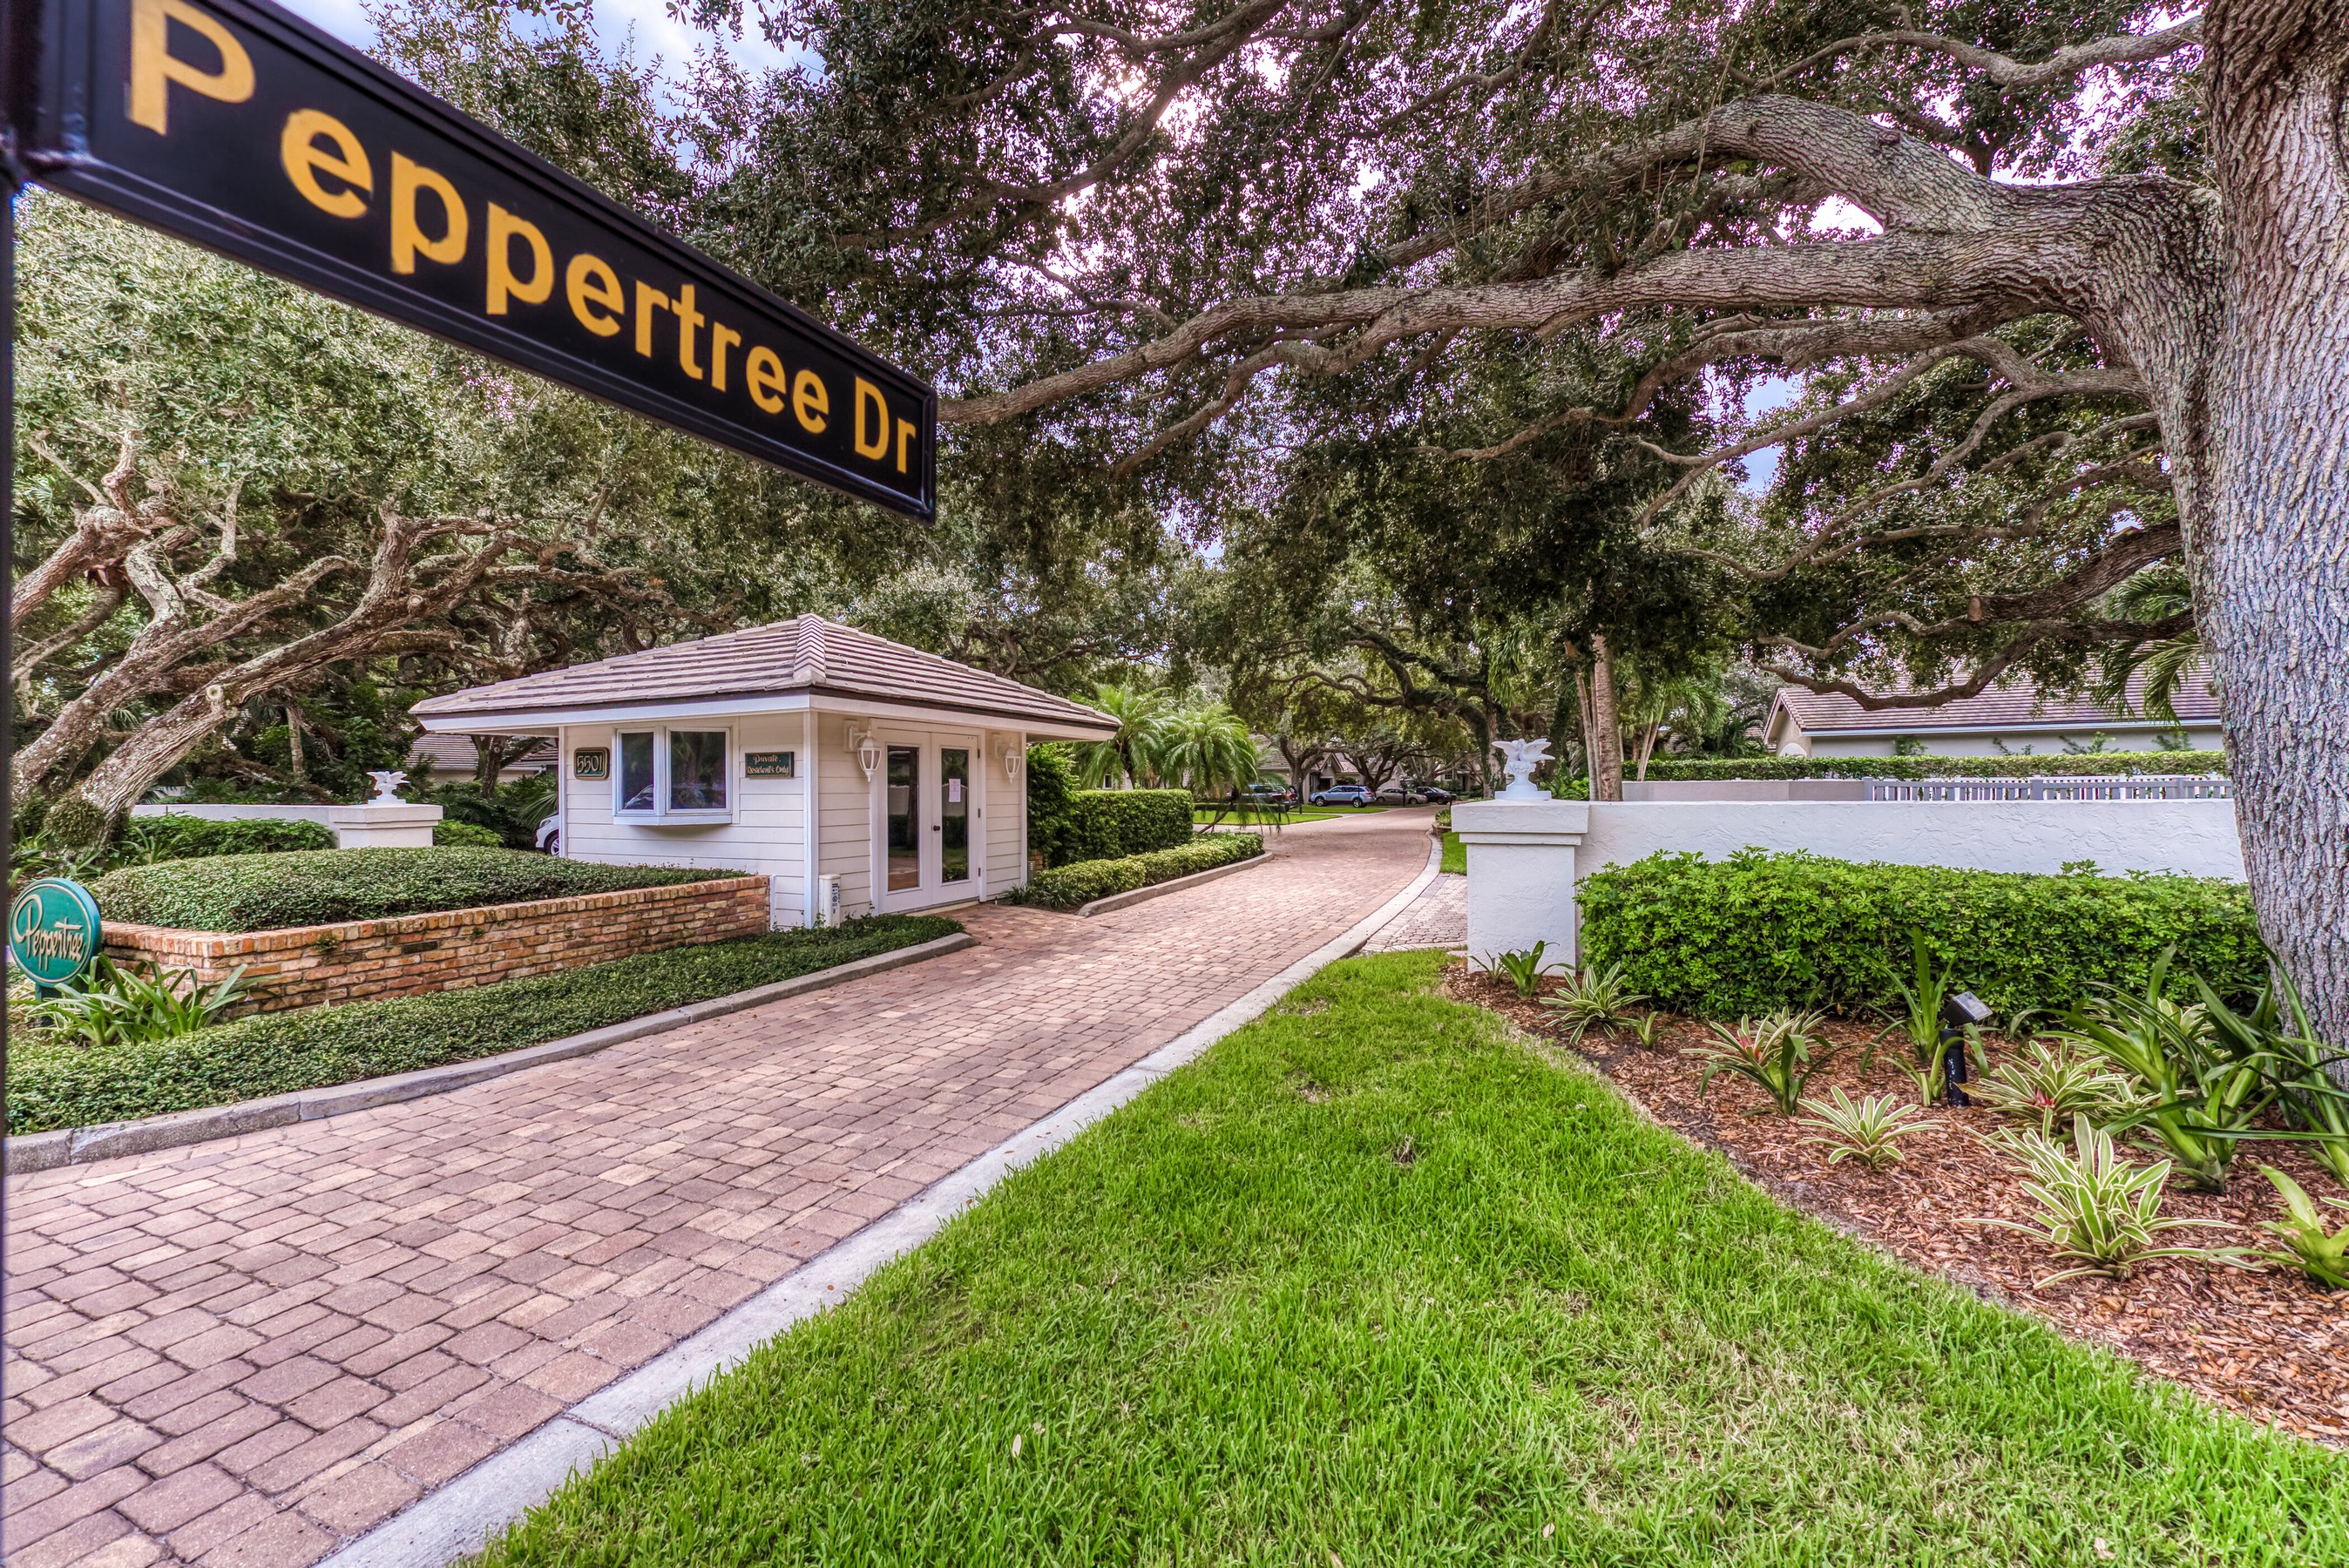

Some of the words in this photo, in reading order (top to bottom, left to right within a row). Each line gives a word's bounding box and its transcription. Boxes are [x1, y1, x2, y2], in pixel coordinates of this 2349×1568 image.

[128, 0, 829, 433] Peppertree
[854, 375, 917, 475] Dr
[577, 755, 602, 774] 5501
[775, 765, 789, 774] Only
